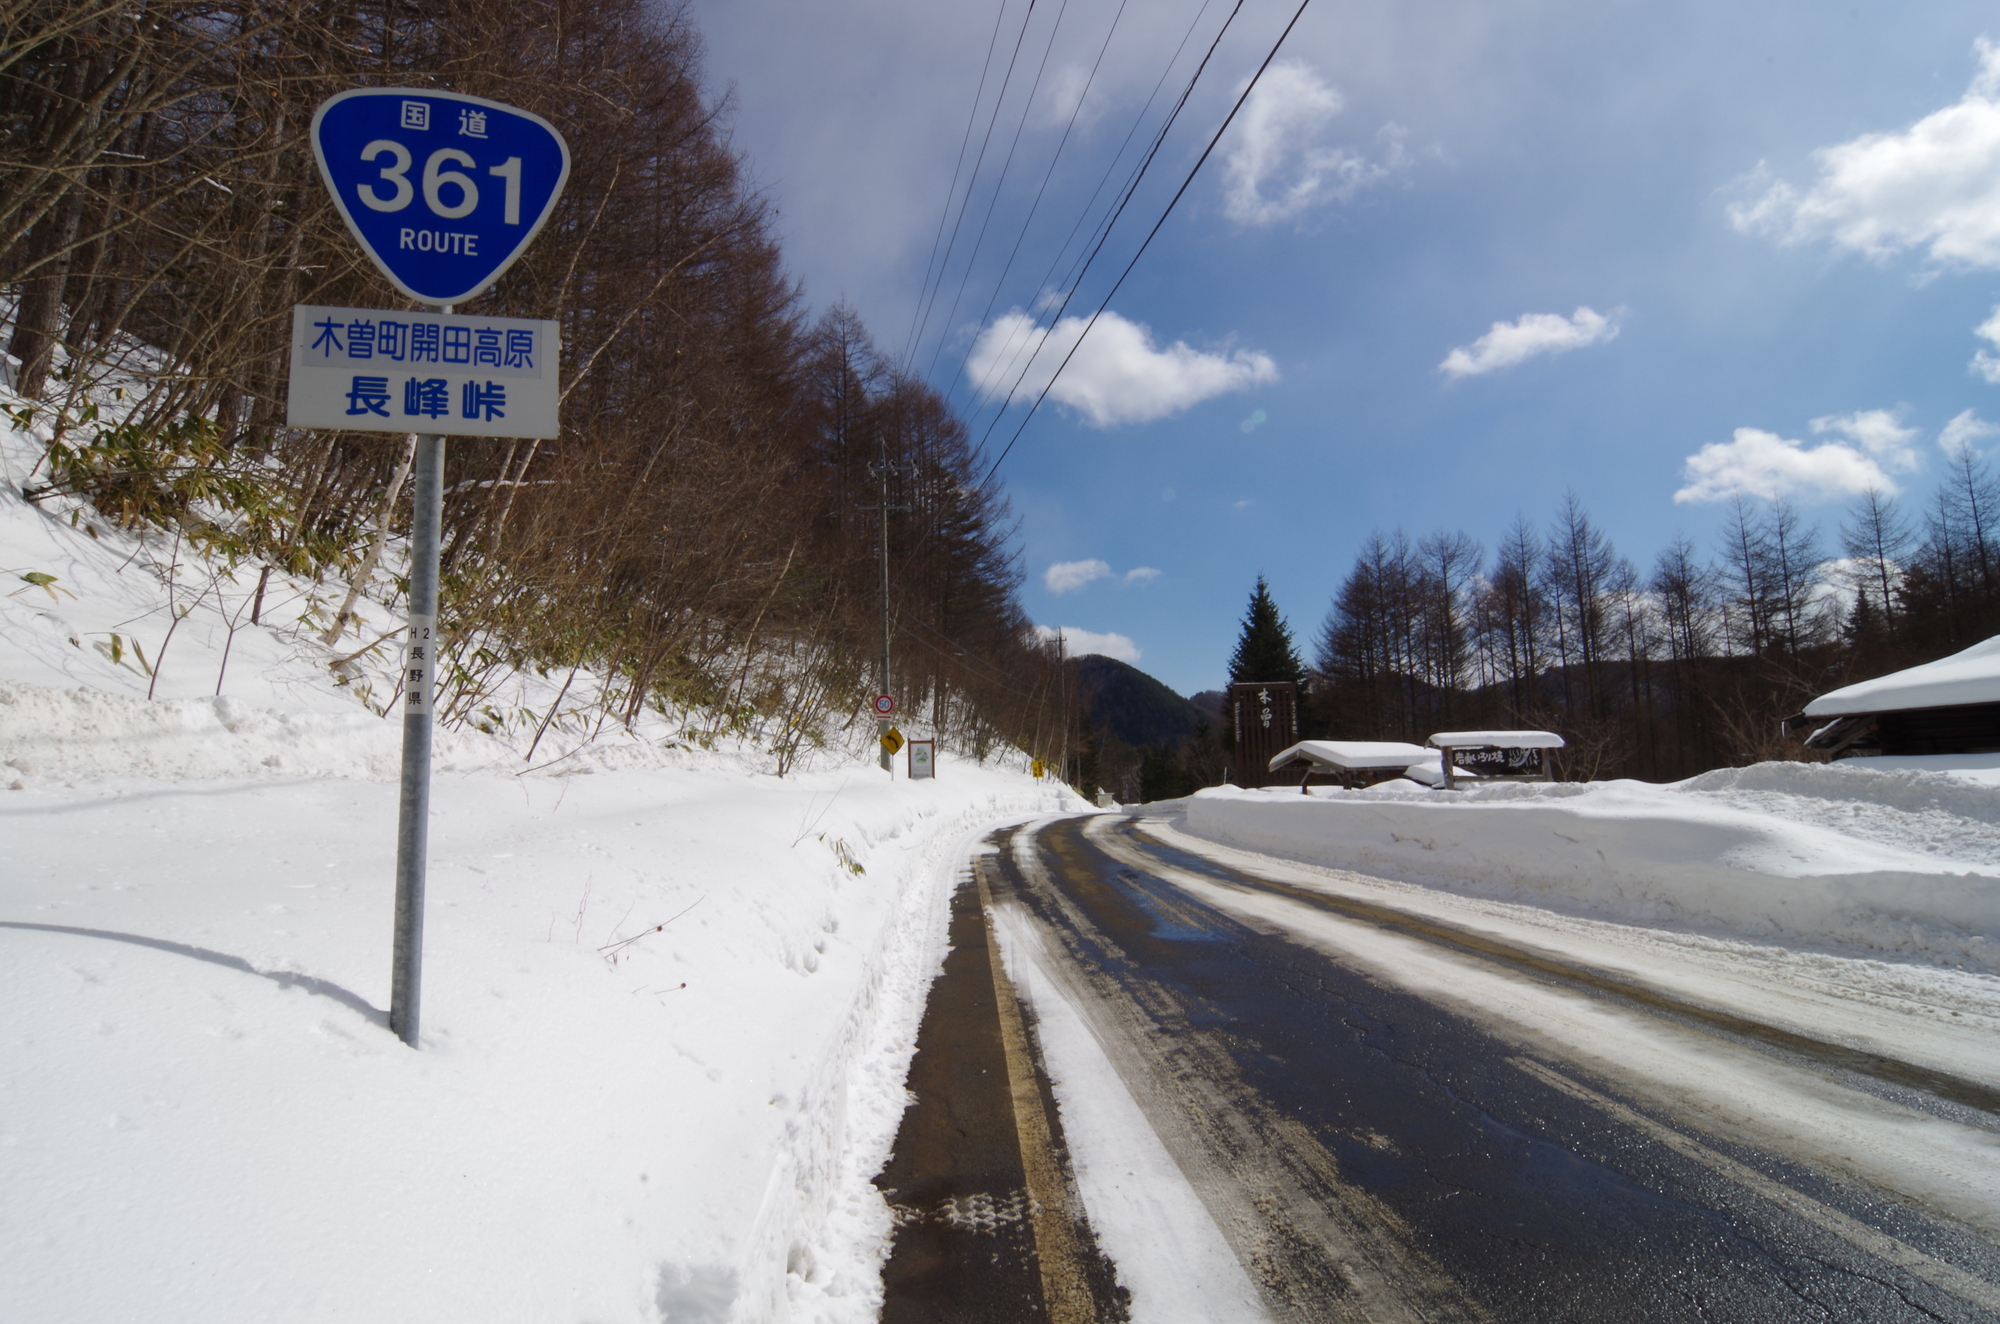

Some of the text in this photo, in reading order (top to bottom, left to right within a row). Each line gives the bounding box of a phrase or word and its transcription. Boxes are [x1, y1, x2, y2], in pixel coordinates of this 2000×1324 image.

[400, 100, 489, 139] 国道
[356, 139, 522, 225] 361
[399, 227, 479, 257] ROUTE
[311, 315, 534, 369] 木曽町開田高原
[345, 376, 506, 422] 長峰峠
[408, 646, 425, 705] 長野県
[879, 699, 890, 709] 50
